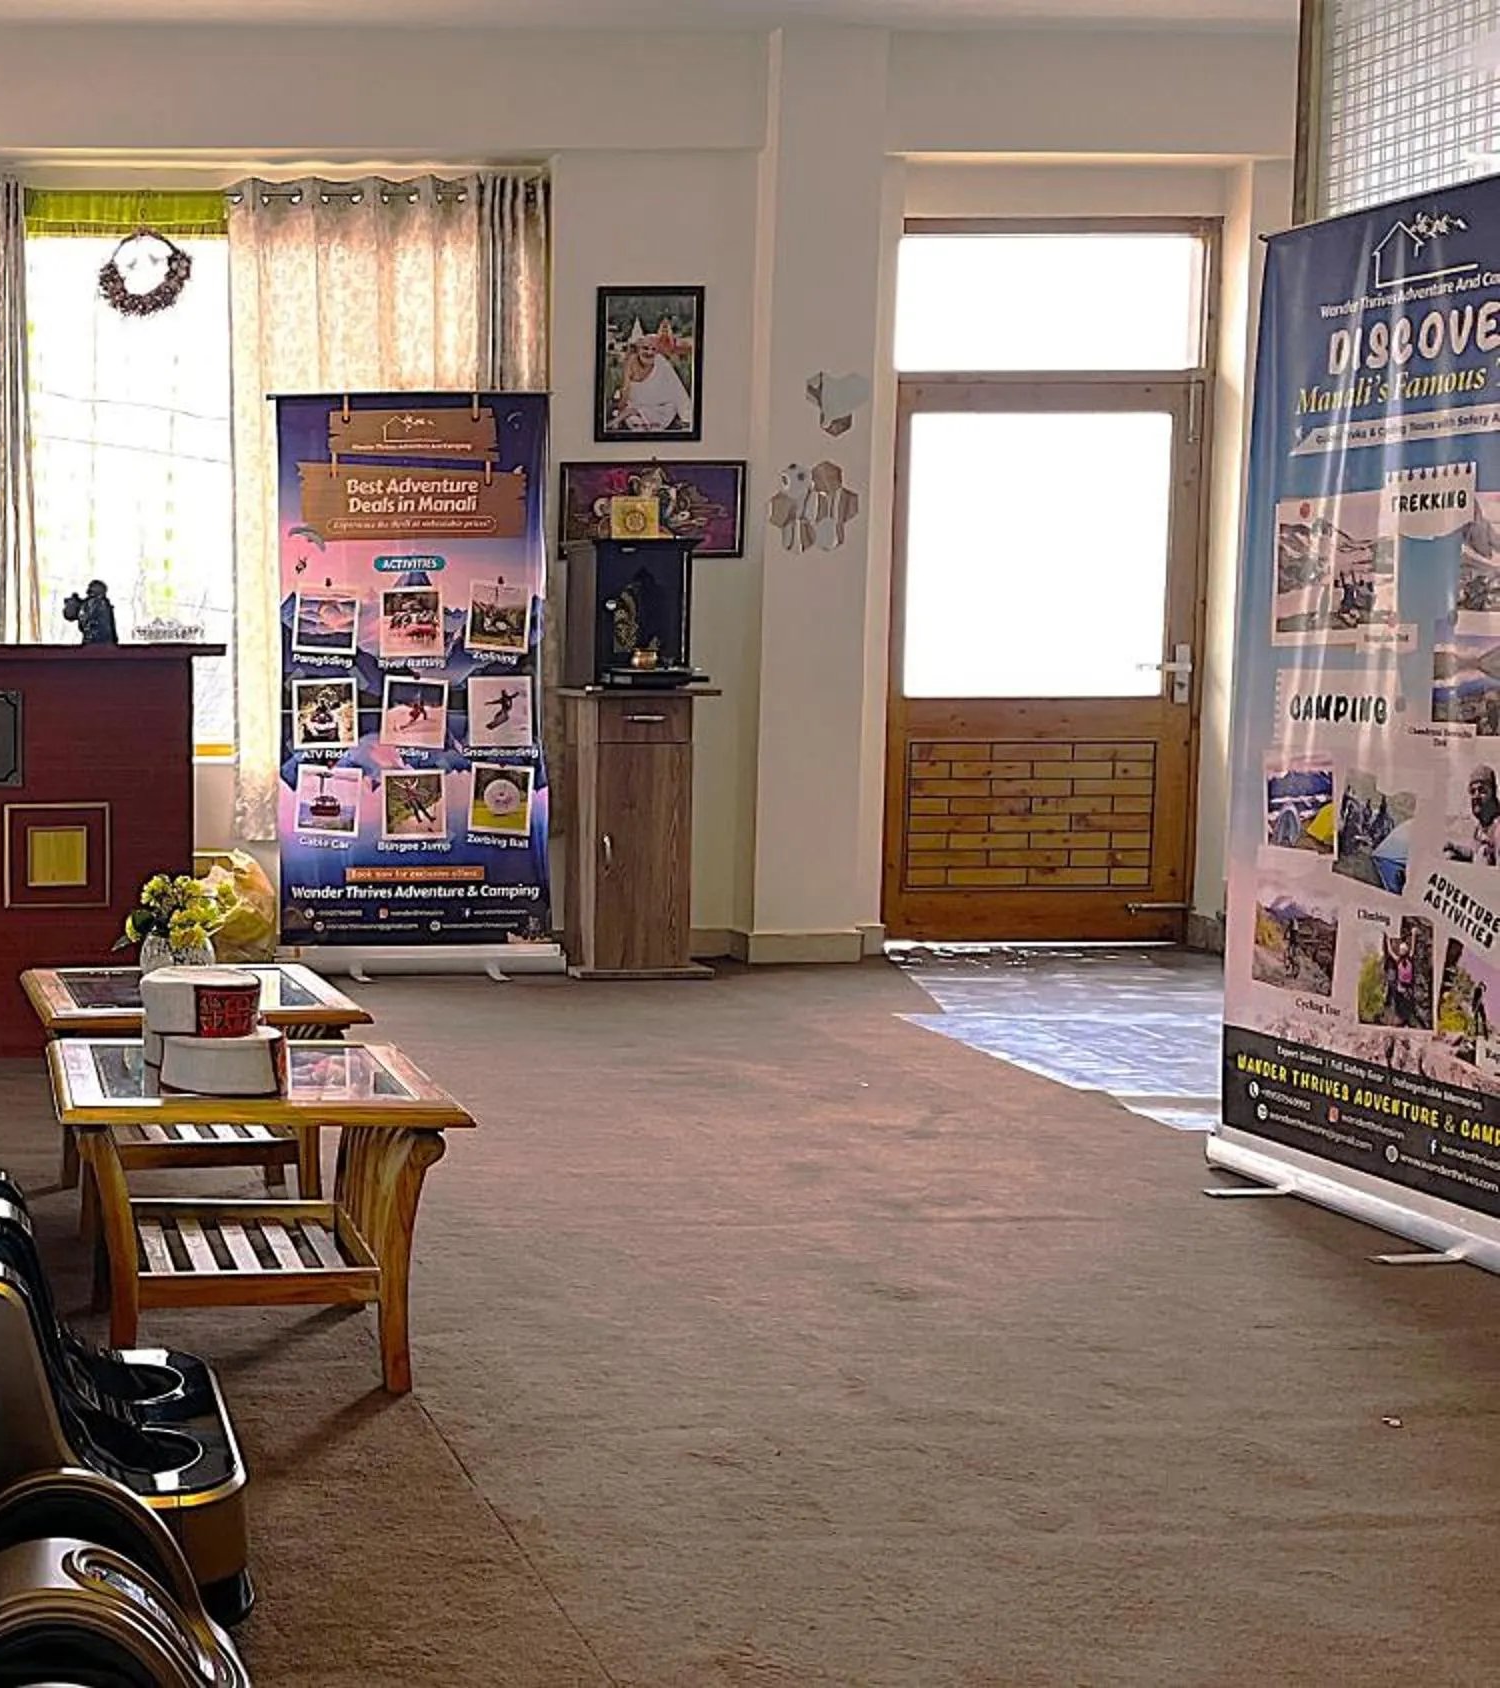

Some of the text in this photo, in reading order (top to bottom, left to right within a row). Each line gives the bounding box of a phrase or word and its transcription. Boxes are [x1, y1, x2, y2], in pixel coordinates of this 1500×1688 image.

[1455, 273, 1481, 294] And
[1395, 368, 1486, 400] Famous
[347, 477, 479, 494] Best Adventure
[348, 495, 477, 513] Deals in Manali
[1391, 489, 1467, 512] TREKKING
[382, 557, 437, 569] ACTIVITIES
[292, 653, 353, 667] Paragliding
[1290, 693, 1388, 725] CAMPING
[302, 750, 324, 760] ATV
[463, 747, 539, 759] Snowboarding
[378, 840, 451, 853] Bungee Jump
[467, 834, 507, 848] Zorbing
[291, 883, 540, 900] Wander Thrives Adventure & Camping
[1428, 873, 1500, 934] ADVENTURE
[1423, 889, 1495, 949] ACTIVITIES
[1295, 998, 1324, 1015] Cycling
[1237, 1053, 1287, 1083] WANDER
[1292, 1069, 1349, 1101] THRIVES
[1354, 1088, 1439, 1128] ADVENTURE
[1444, 1113, 1455, 1133] &
